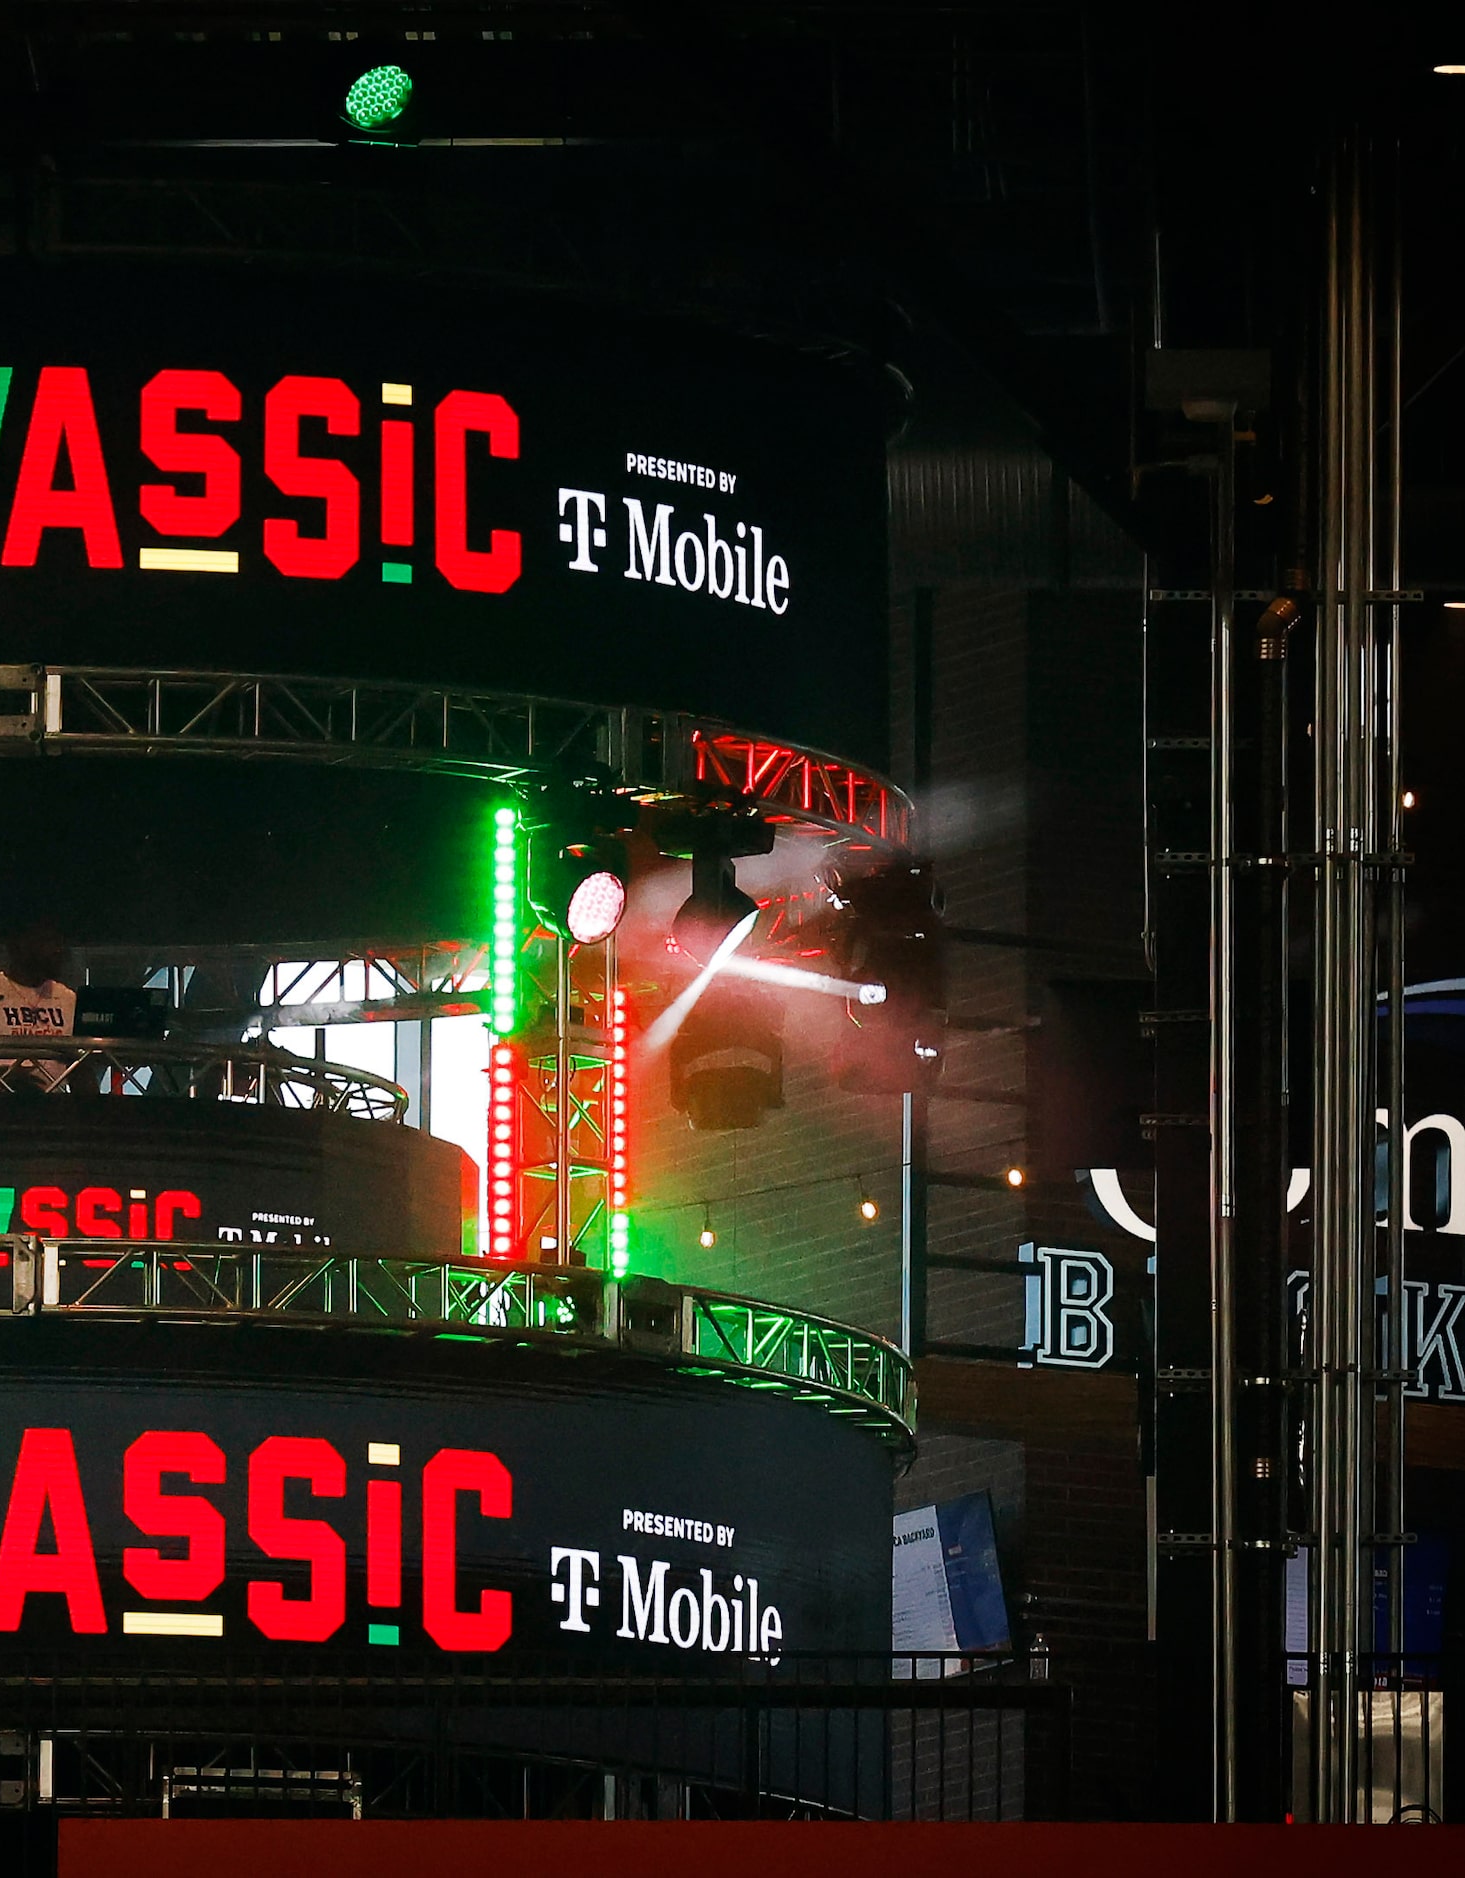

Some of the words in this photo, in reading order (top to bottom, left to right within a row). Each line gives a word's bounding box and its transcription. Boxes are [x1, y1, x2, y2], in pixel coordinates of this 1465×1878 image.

[626, 453, 716, 489] PRESENTED
[719, 472, 737, 494] BY
[622, 497, 790, 615] Mobile
[3, 1007, 64, 1027] HBCU
[251, 1212, 302, 1226] PRESENTED
[303, 1217, 315, 1226] BY
[623, 1509, 713, 1543] PRESENTED
[717, 1525, 735, 1548] BY
[616, 1555, 783, 1667] Mobile
